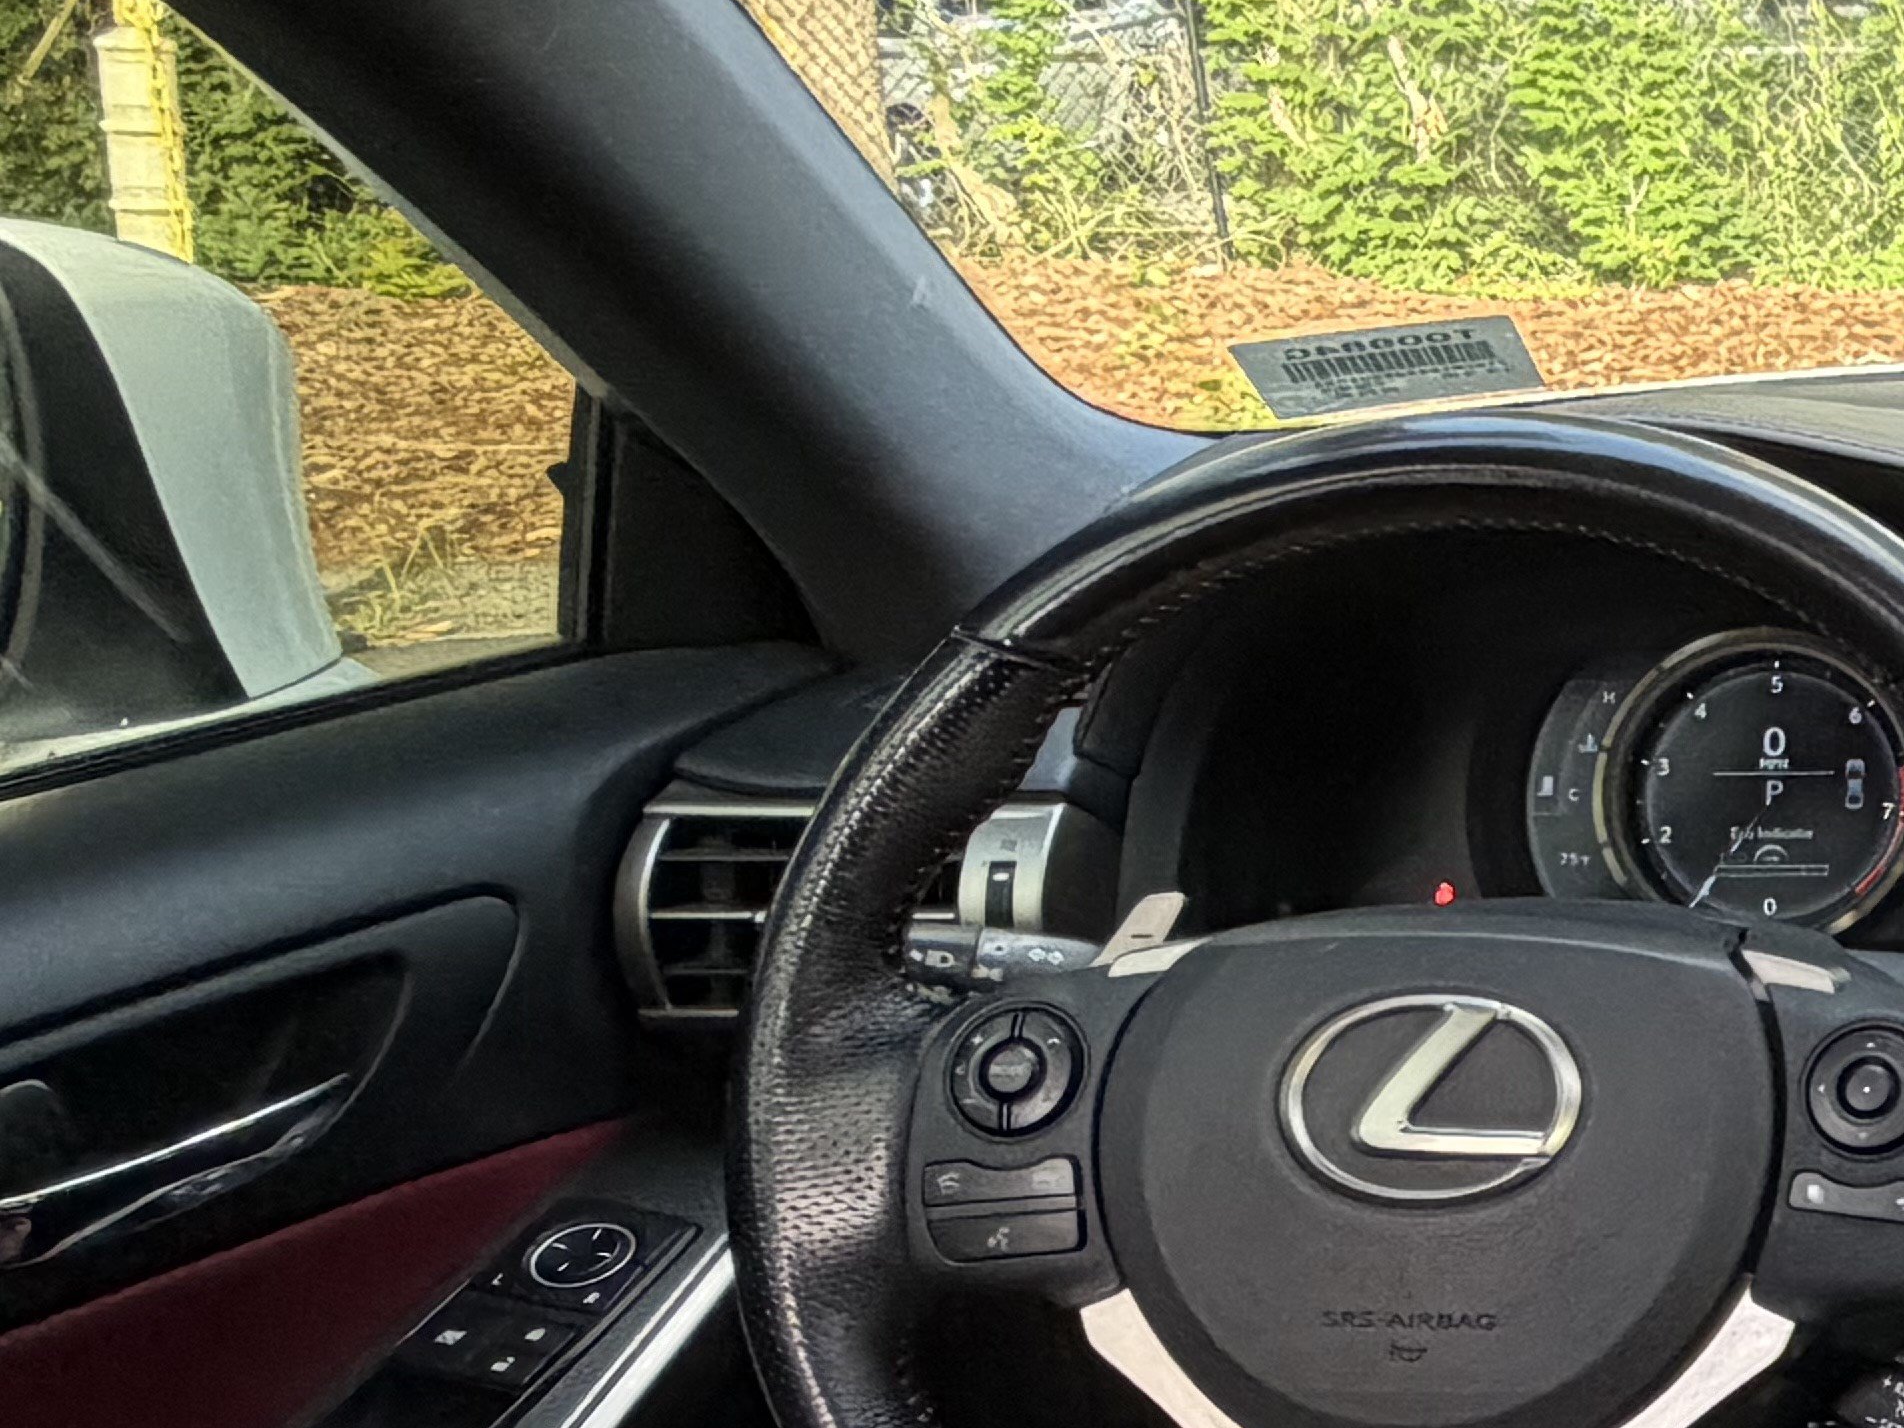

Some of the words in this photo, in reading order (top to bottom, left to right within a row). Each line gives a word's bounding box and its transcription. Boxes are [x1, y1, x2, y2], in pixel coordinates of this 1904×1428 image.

[1769, 675, 1784, 694] 5
[1694, 702, 1708, 721] 4
[1847, 706, 1863, 725] 6
[1762, 726, 1787, 758] 0
[1656, 756, 1671, 777] 3
[1765, 778, 1785, 807] P
[1880, 801, 1895, 821] 7
[1658, 825, 1673, 844] 2
[1762, 897, 1778, 917] 0
